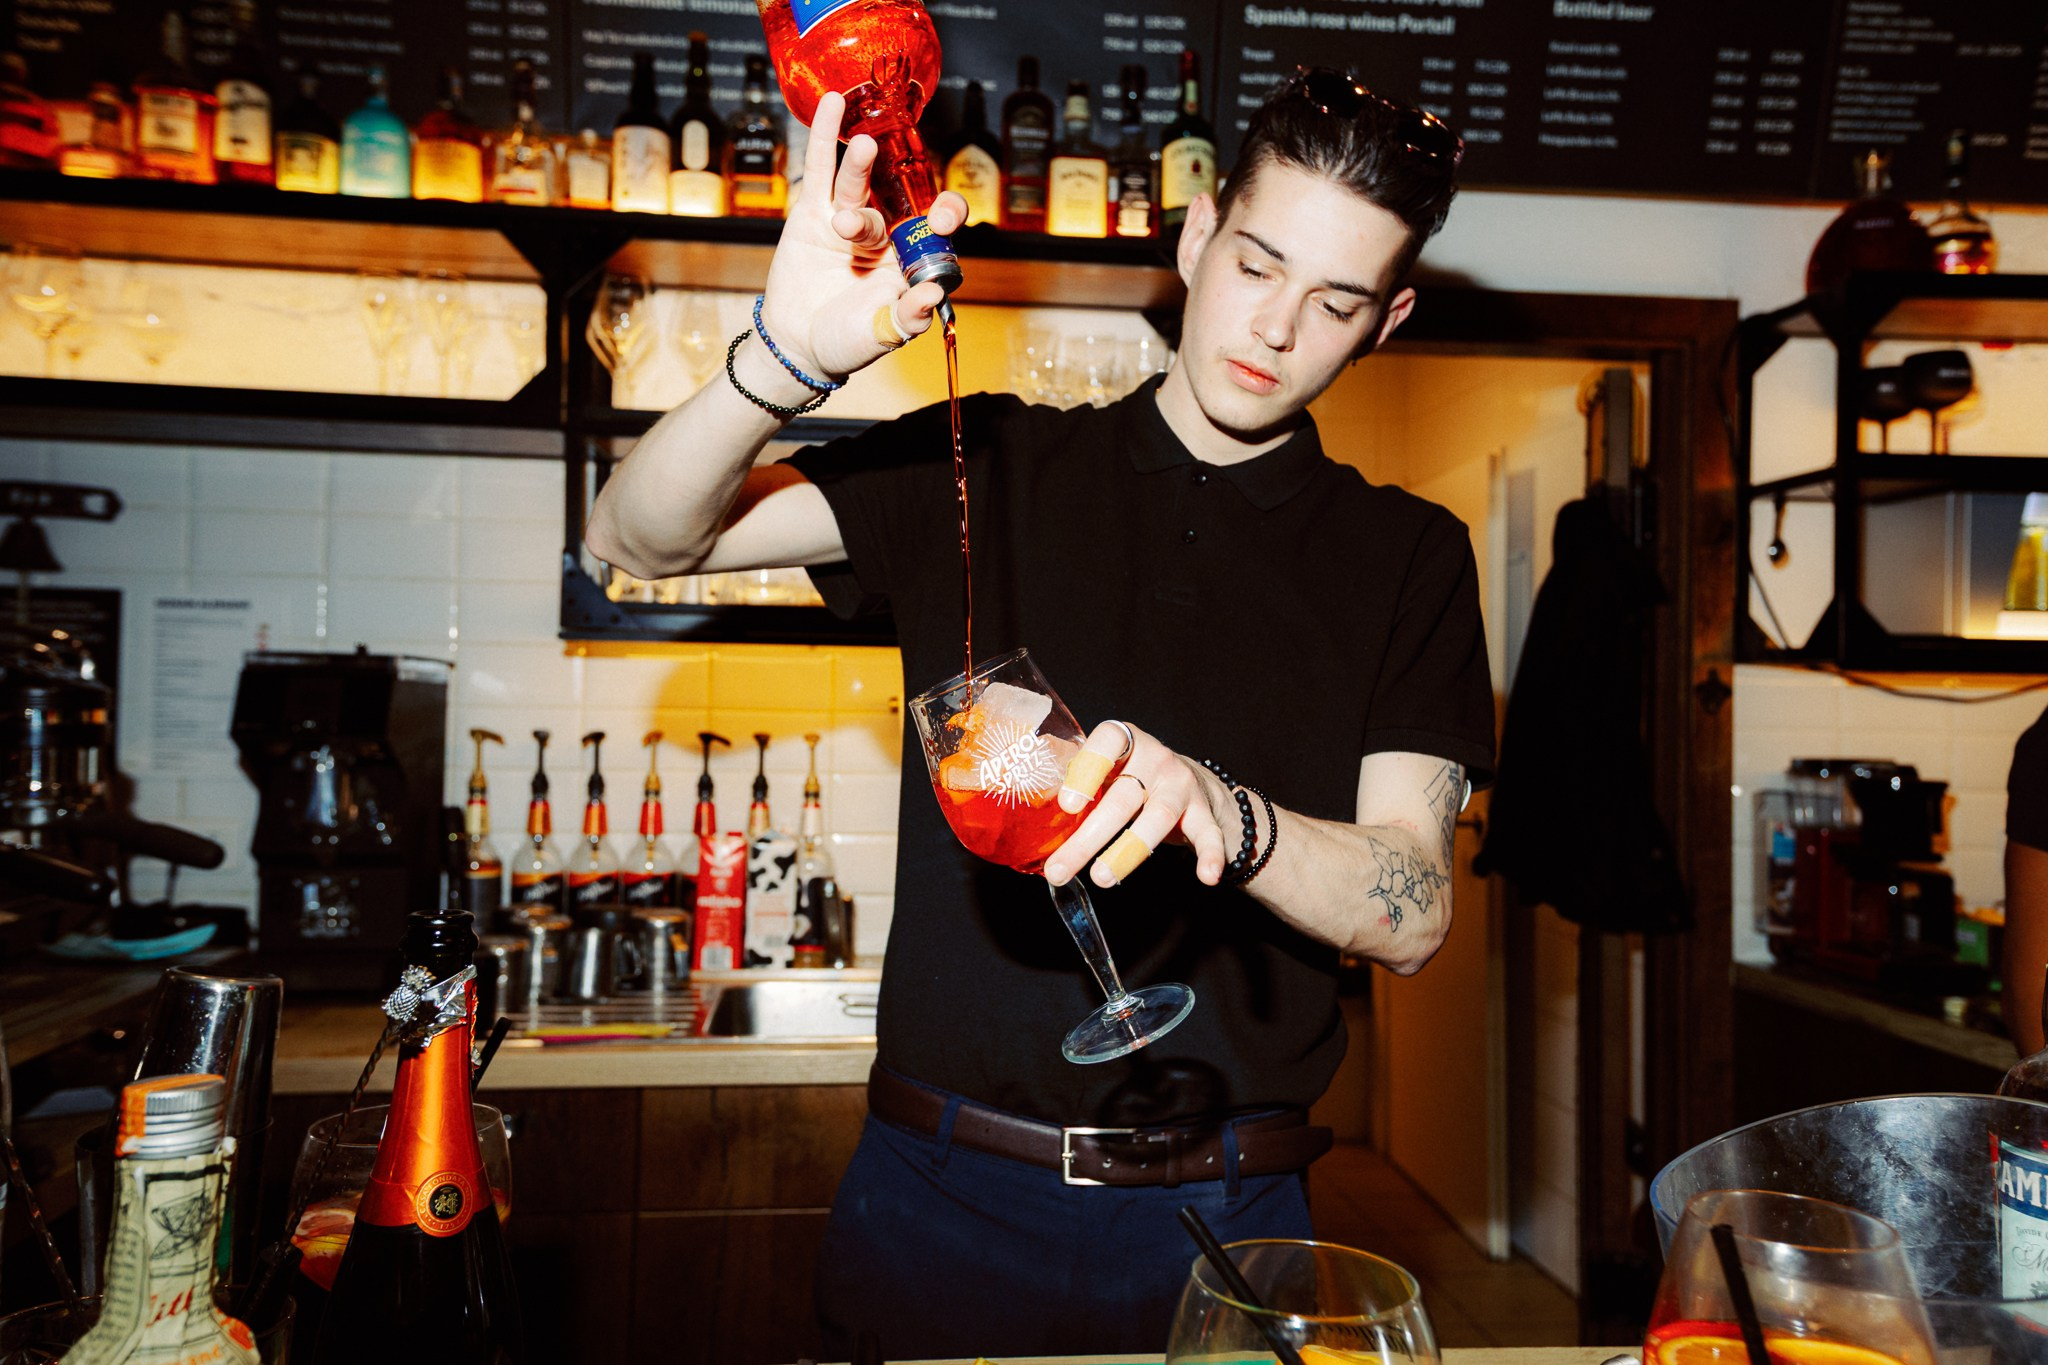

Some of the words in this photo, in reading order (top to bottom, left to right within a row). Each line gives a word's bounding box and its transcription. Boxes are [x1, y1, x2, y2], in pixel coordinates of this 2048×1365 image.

[1244, 4, 1309, 28] Spanish
[1311, 13, 1347, 29] rose
[1349, 12, 1396, 32] wines
[1553, 1, 1612, 21] Bottled
[1614, 4, 1653, 23] beer
[906, 225, 935, 246] EROL
[980, 727, 1045, 791] APEROL
[2001, 1160, 2048, 1210] AM
